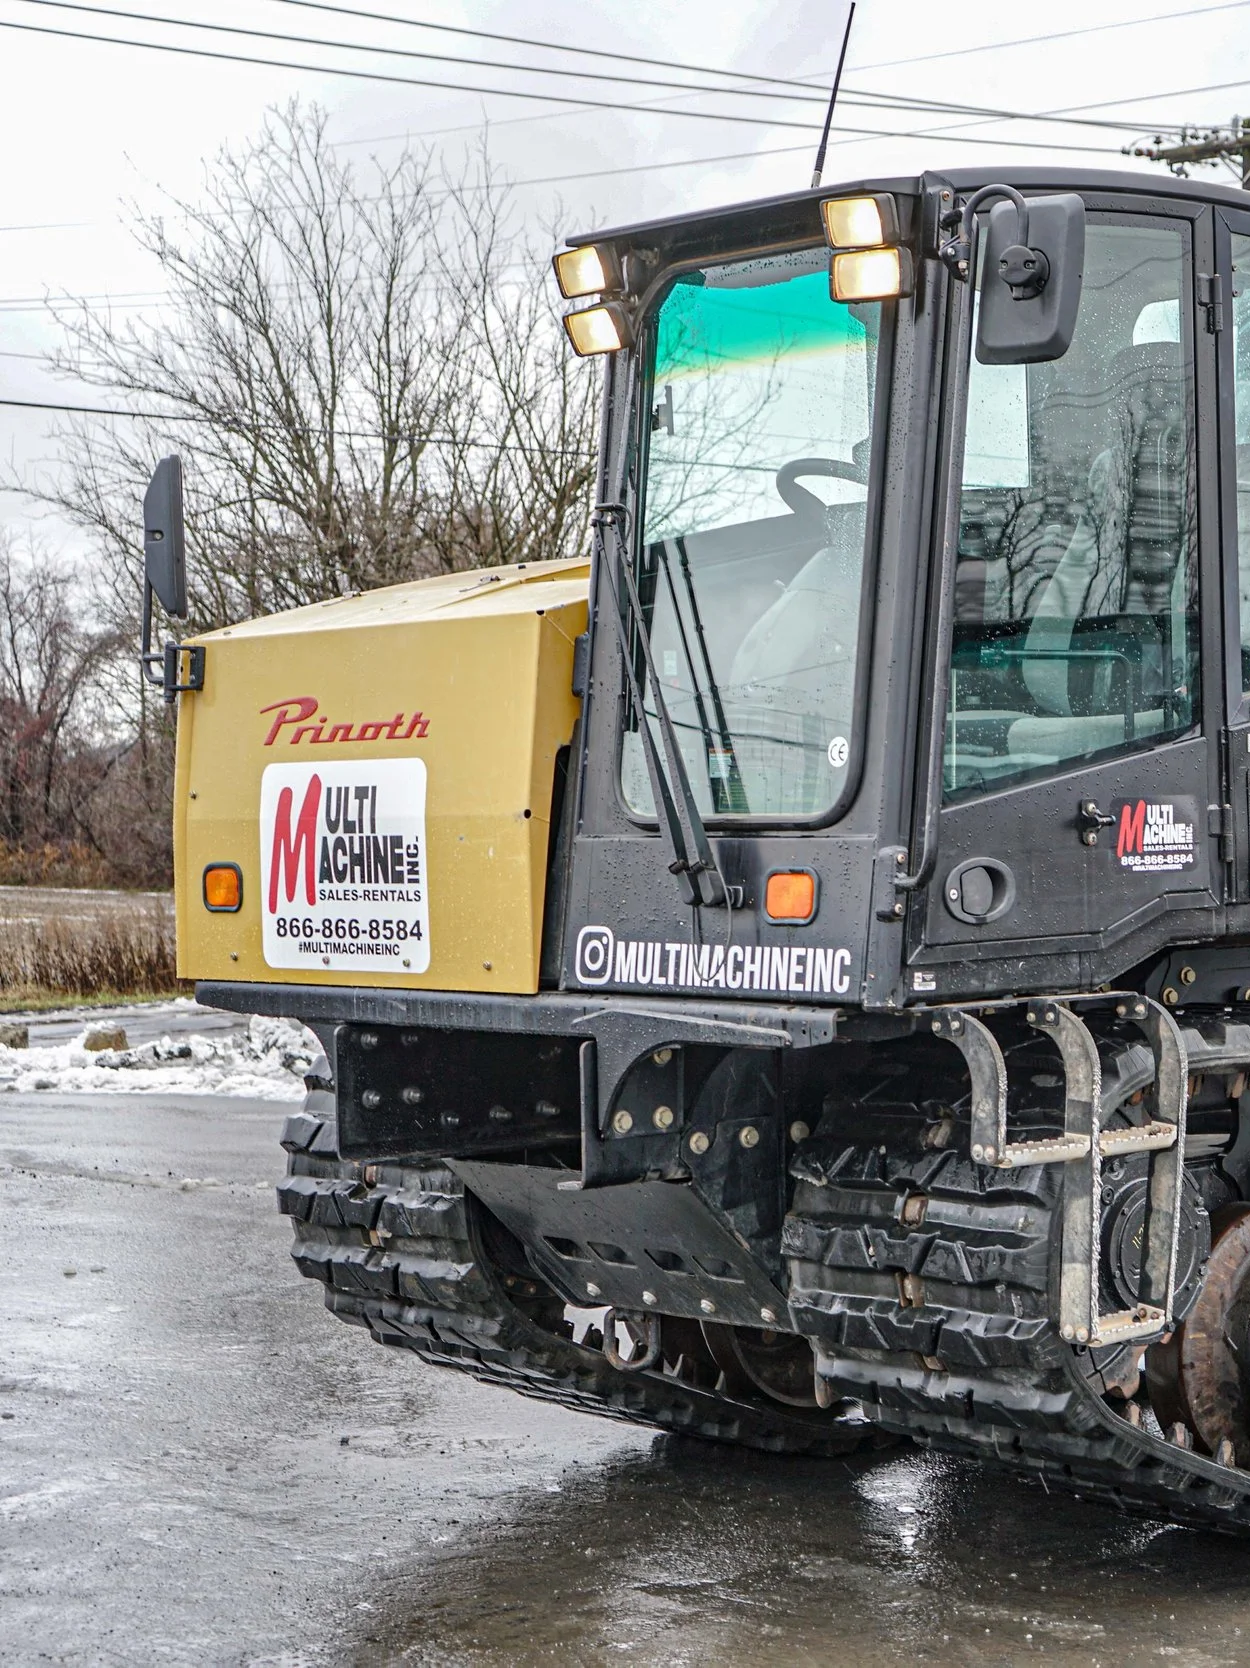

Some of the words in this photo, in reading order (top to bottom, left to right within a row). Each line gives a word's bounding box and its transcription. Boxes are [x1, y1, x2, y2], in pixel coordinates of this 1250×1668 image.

[260, 696, 430, 746] Prinoth
[1143, 844, 1193, 852] SALES-RENTALS
[1121, 853, 1194, 866] 866-866-8584
[319, 889, 422, 902] SALES-RENTALS
[276, 917, 423, 941] 866-866-8584
[298, 941, 400, 956] #MULTIMACHINEINC
[614, 941, 851, 994] MULTIMACHINEINC
